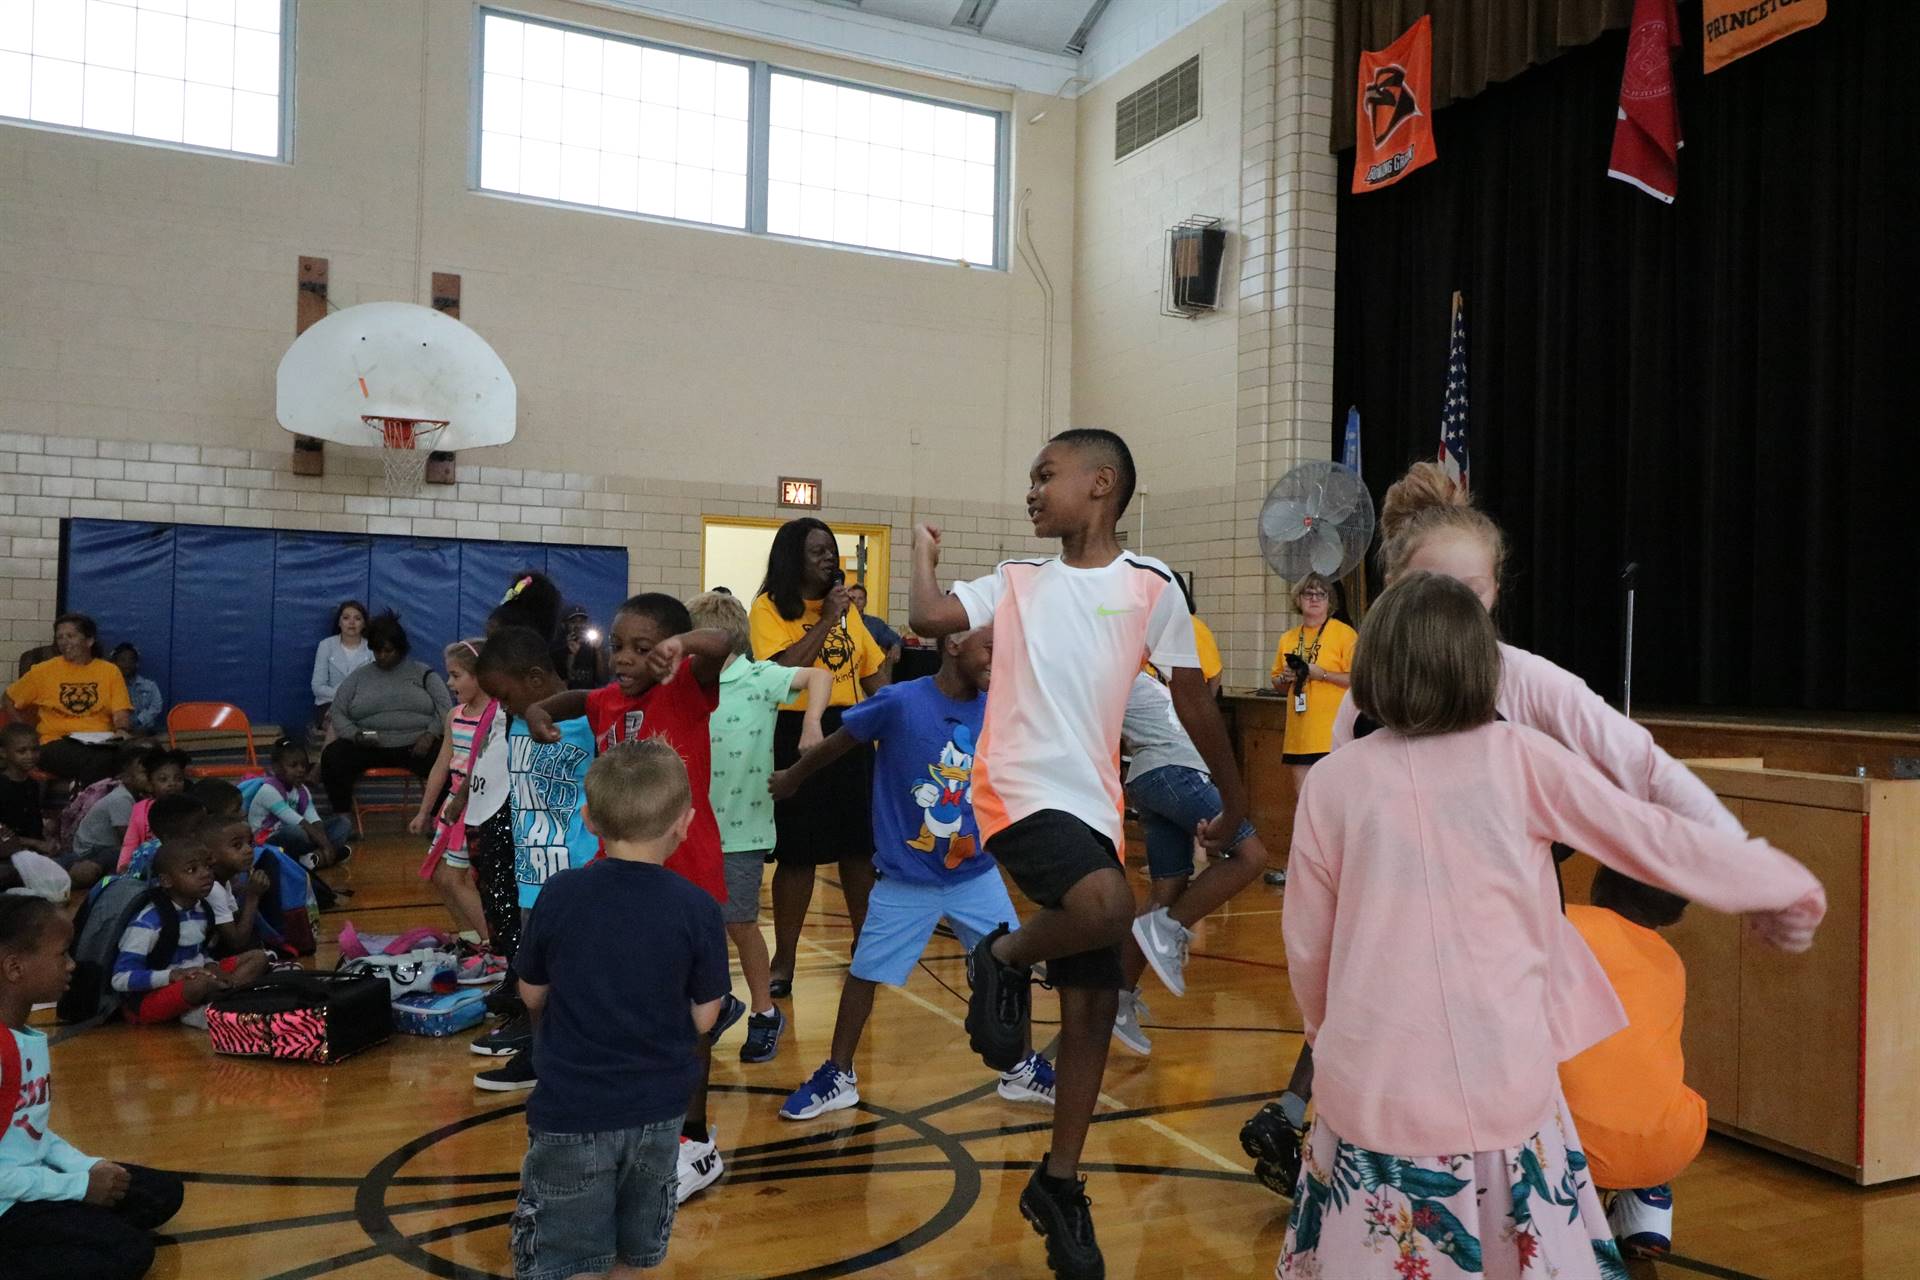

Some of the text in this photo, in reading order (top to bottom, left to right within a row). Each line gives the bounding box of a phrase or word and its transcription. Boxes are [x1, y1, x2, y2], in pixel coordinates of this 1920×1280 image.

[1706, 0, 1803, 42] PRINCET
[783, 482, 817, 505] EXIT
[510, 735, 588, 780] WORK
[515, 847, 569, 884] ARD
